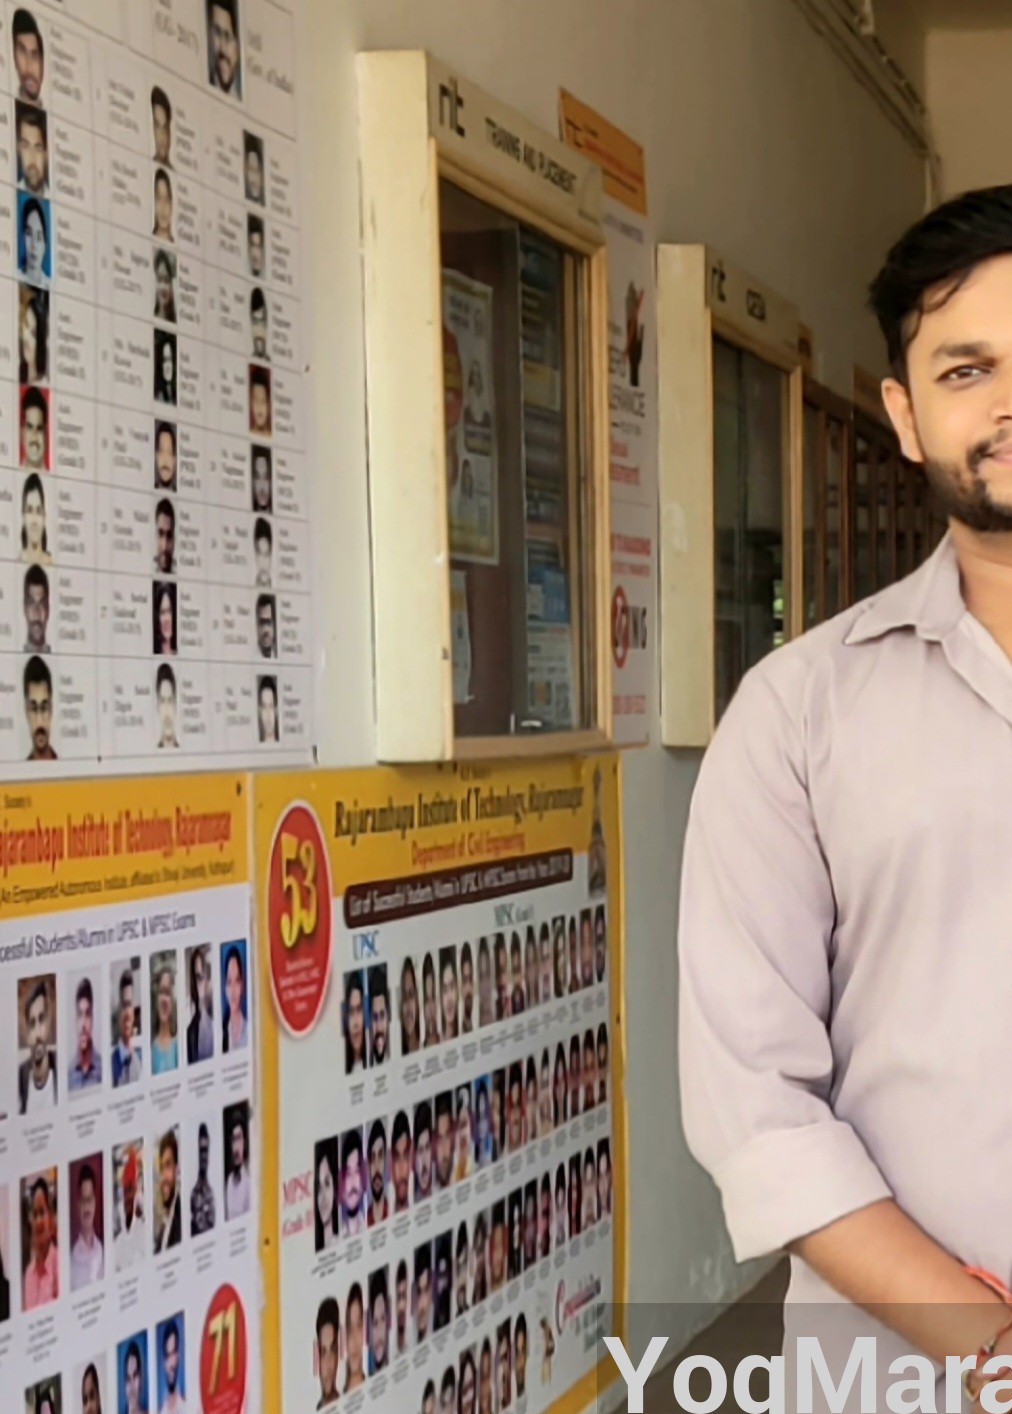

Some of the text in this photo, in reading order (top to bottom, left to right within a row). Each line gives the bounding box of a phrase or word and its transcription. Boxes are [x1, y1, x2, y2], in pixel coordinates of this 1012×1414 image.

[335, 795, 415, 847] Rajarambapu
[418, 791, 458, 829] Institute
[461, 787, 472, 824] of
[281, 832, 318, 948] 53
[208, 1301, 238, 1396] 71
